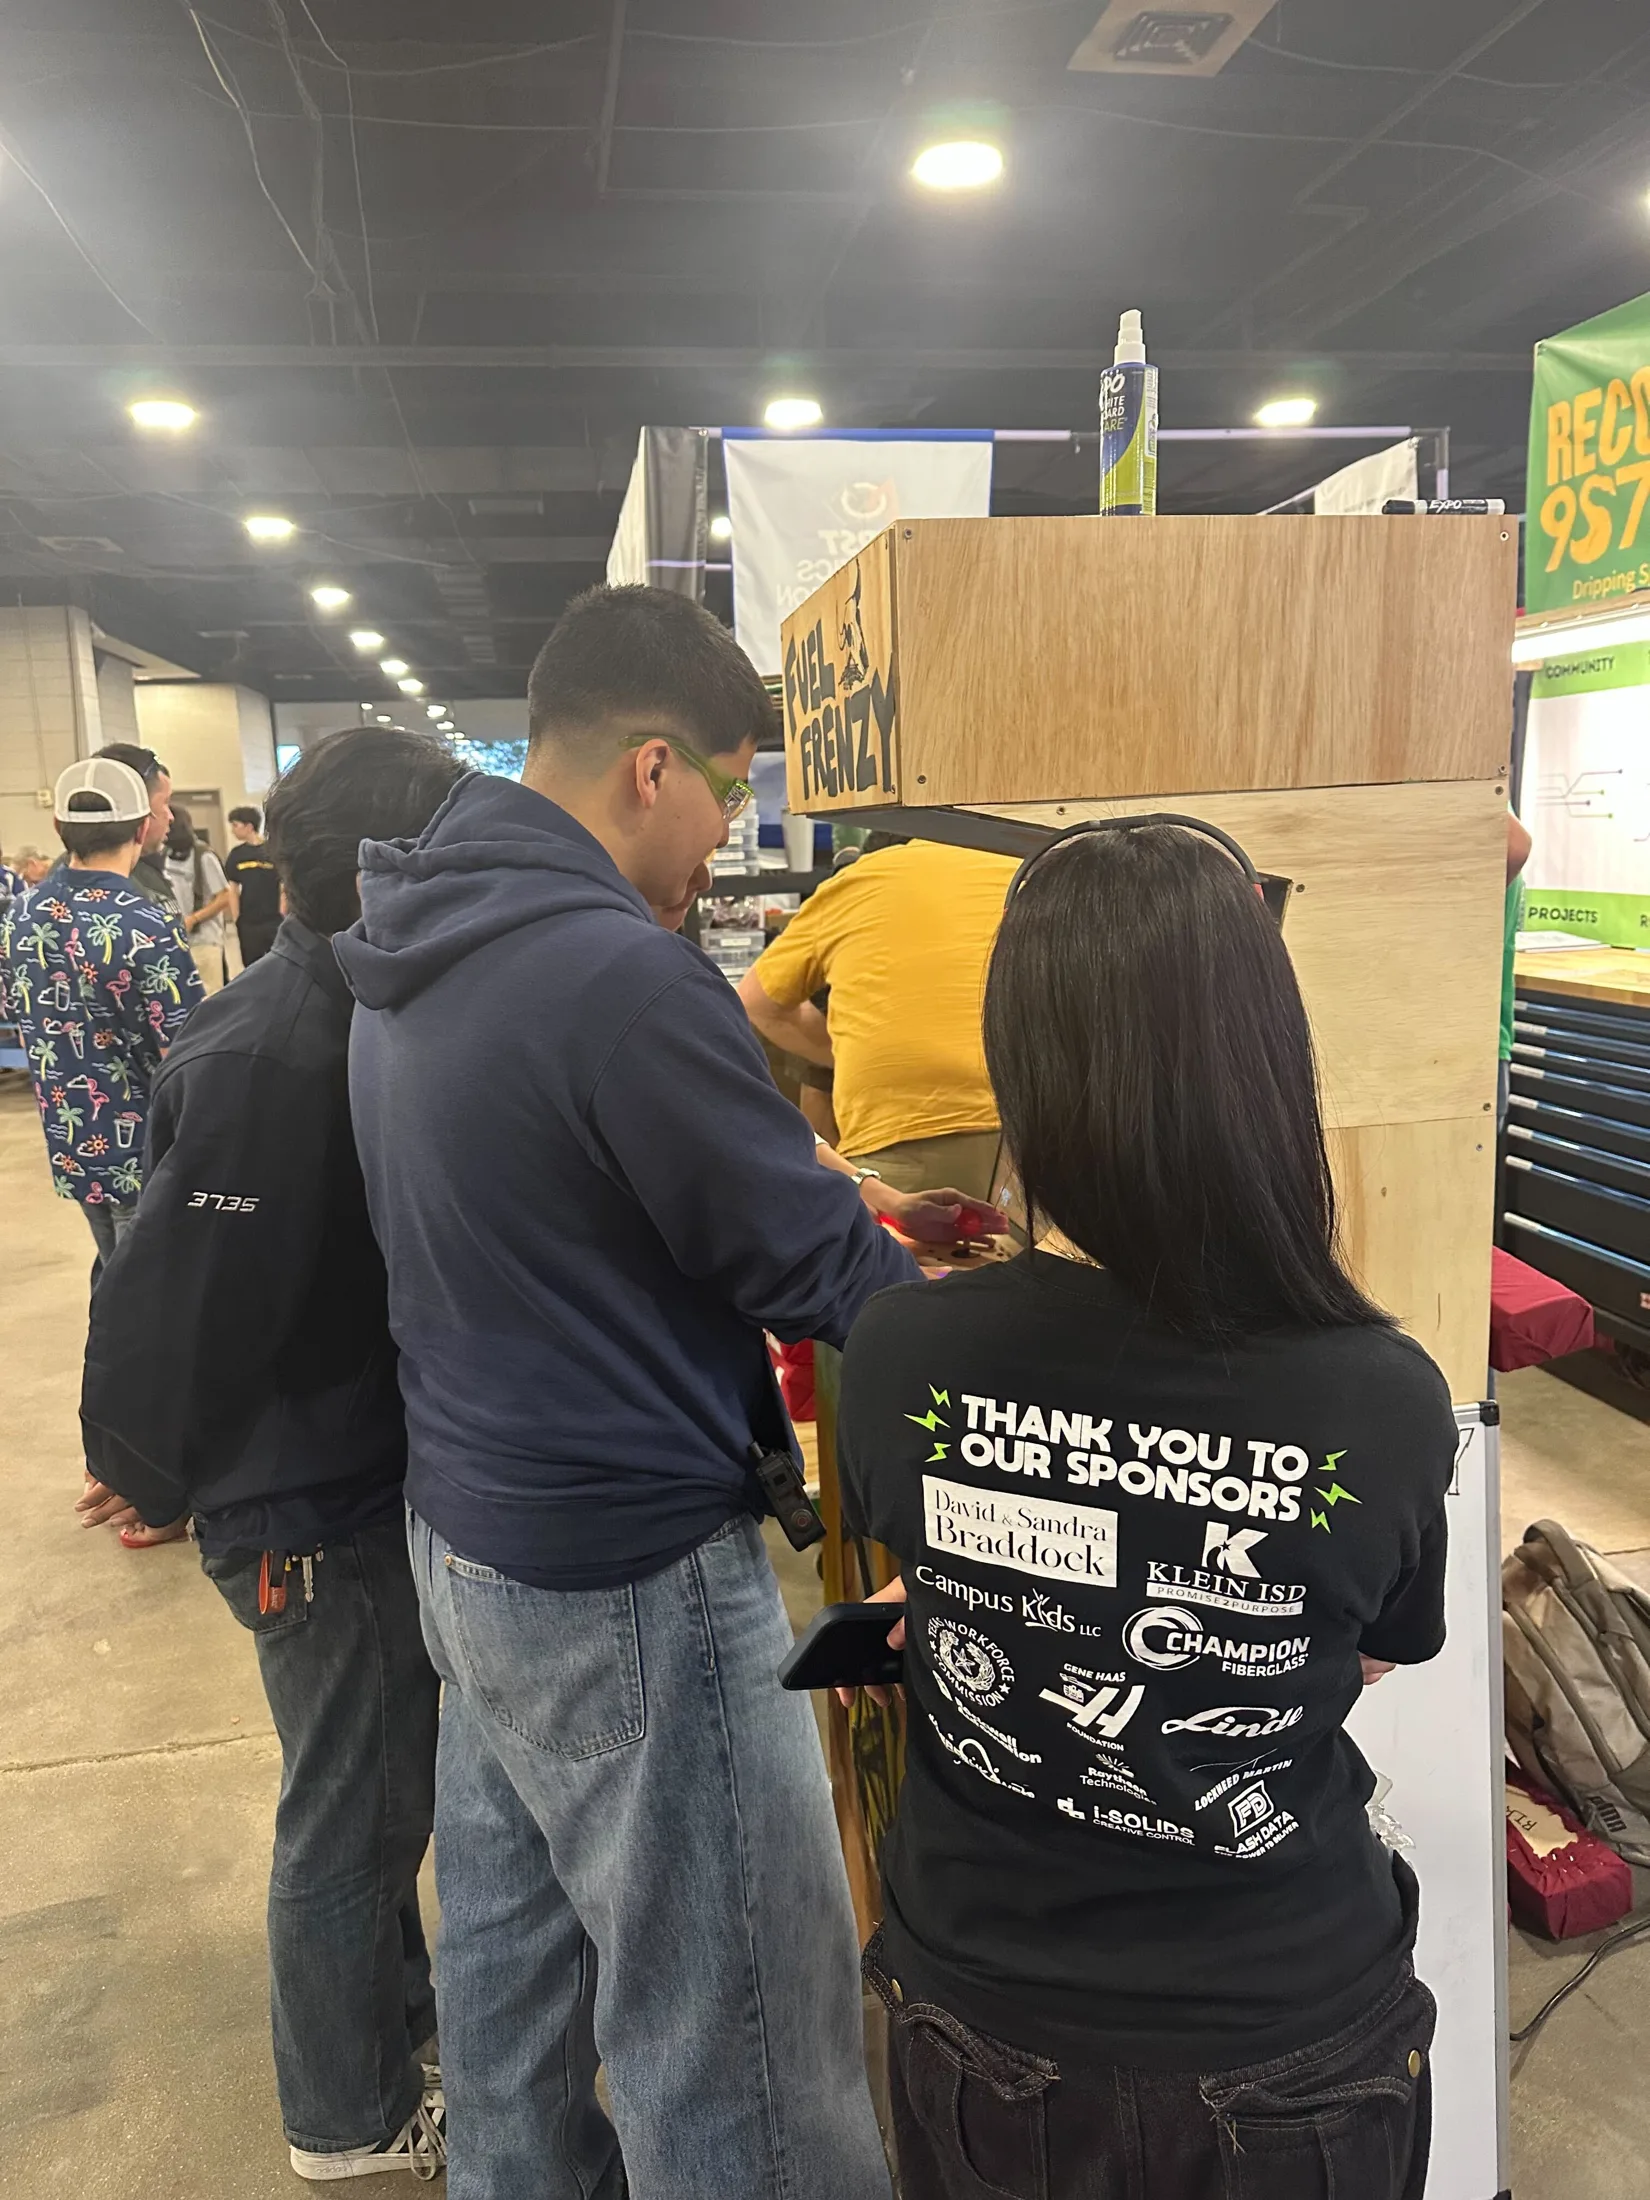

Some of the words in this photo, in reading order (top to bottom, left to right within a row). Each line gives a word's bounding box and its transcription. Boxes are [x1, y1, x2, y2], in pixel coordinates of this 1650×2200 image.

[1429, 500, 1462, 513] EXPO
[1573, 570, 1636, 600] Dripping
[784, 618, 836, 743] FUEL
[1545, 656, 1615, 679] COMMUNITY
[800, 652, 896, 800] FRENZY
[1528, 906, 1598, 923] PROJECTS
[187, 1191, 260, 1212] 3735
[960, 1394, 1113, 1453] THANK
[1128, 1423, 1232, 1471] YOU
[1247, 1440, 1309, 1482] TO
[960, 1433, 1051, 1479] OUR
[1066, 1451, 1303, 1522] SPONSORS
[935, 1489, 995, 1523] David
[1001, 1513, 1013, 1526] &
[1017, 1507, 1107, 1542] Sandra
[935, 1515, 1105, 1577] Braddock
[1147, 1561, 1249, 1598] KLEIN
[1257, 1583, 1307, 1602] ISD
[915, 1565, 1014, 1613] Campus
[1022, 1588, 1076, 1633] Kids
[1079, 1624, 1102, 1637] LLC
[1157, 1586, 1295, 1614] PROMISE2PURPOSE
[944, 1618, 1015, 1682] WORKFORCE
[1166, 1631, 1311, 1663] CHAMPION
[933, 1653, 1005, 1707] COMMISSION
[1063, 1662, 1094, 1679] GENE
[1095, 1671, 1126, 1683] HAAS
[1221, 1655, 1308, 1677] FIBERGLASS
[1066, 1722, 1125, 1751] FOUNDATION
[1161, 1705, 1304, 1738] Linde
[1088, 1766, 1148, 1797] Raytheon
[1194, 1773, 1240, 1811] LOCKHEED
[1242, 1759, 1293, 1780] MARTIN
[1093, 1805, 1195, 1839] i-SOLIDS
[1093, 1818, 1144, 1837] CREATIVE
[1146, 1831, 1196, 1846] CONTROL
[1260, 1810, 1295, 1840] DATA
